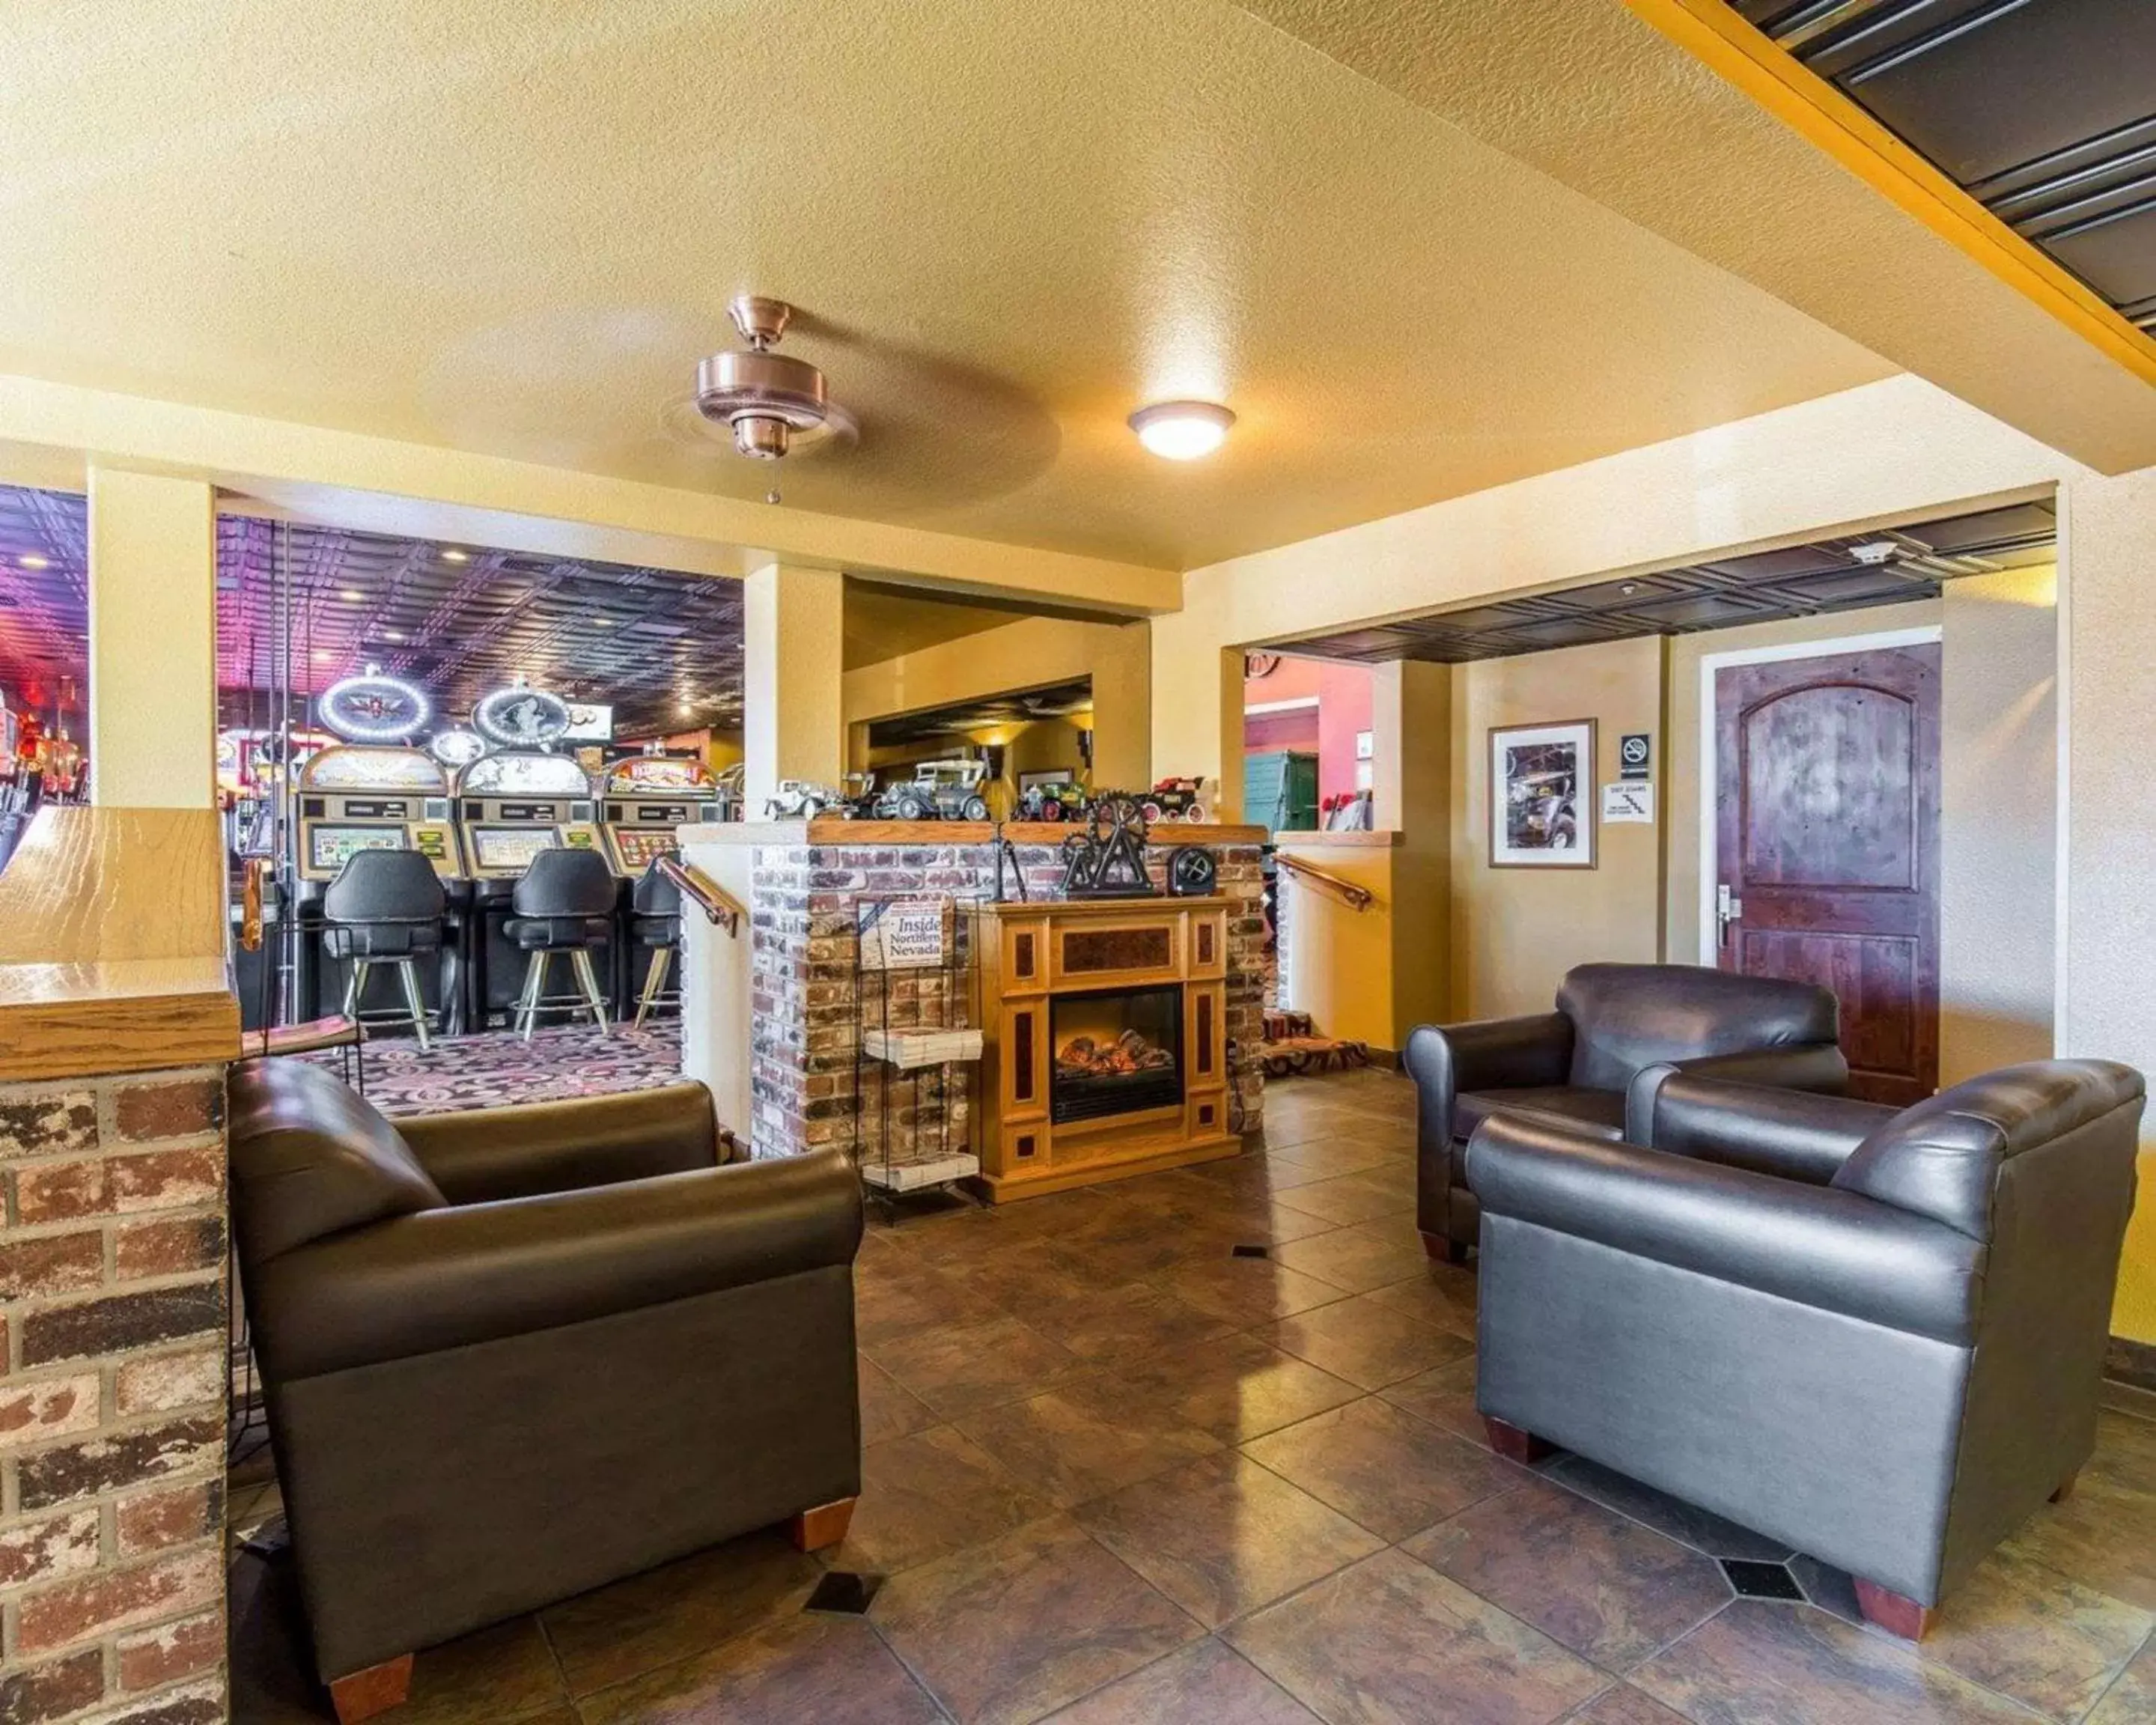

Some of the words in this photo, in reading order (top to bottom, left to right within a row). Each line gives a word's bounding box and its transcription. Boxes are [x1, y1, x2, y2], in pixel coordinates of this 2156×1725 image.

[898, 917, 941, 932] Inside
[890, 933, 941, 944] Northern
[890, 944, 940, 956] Nevada
